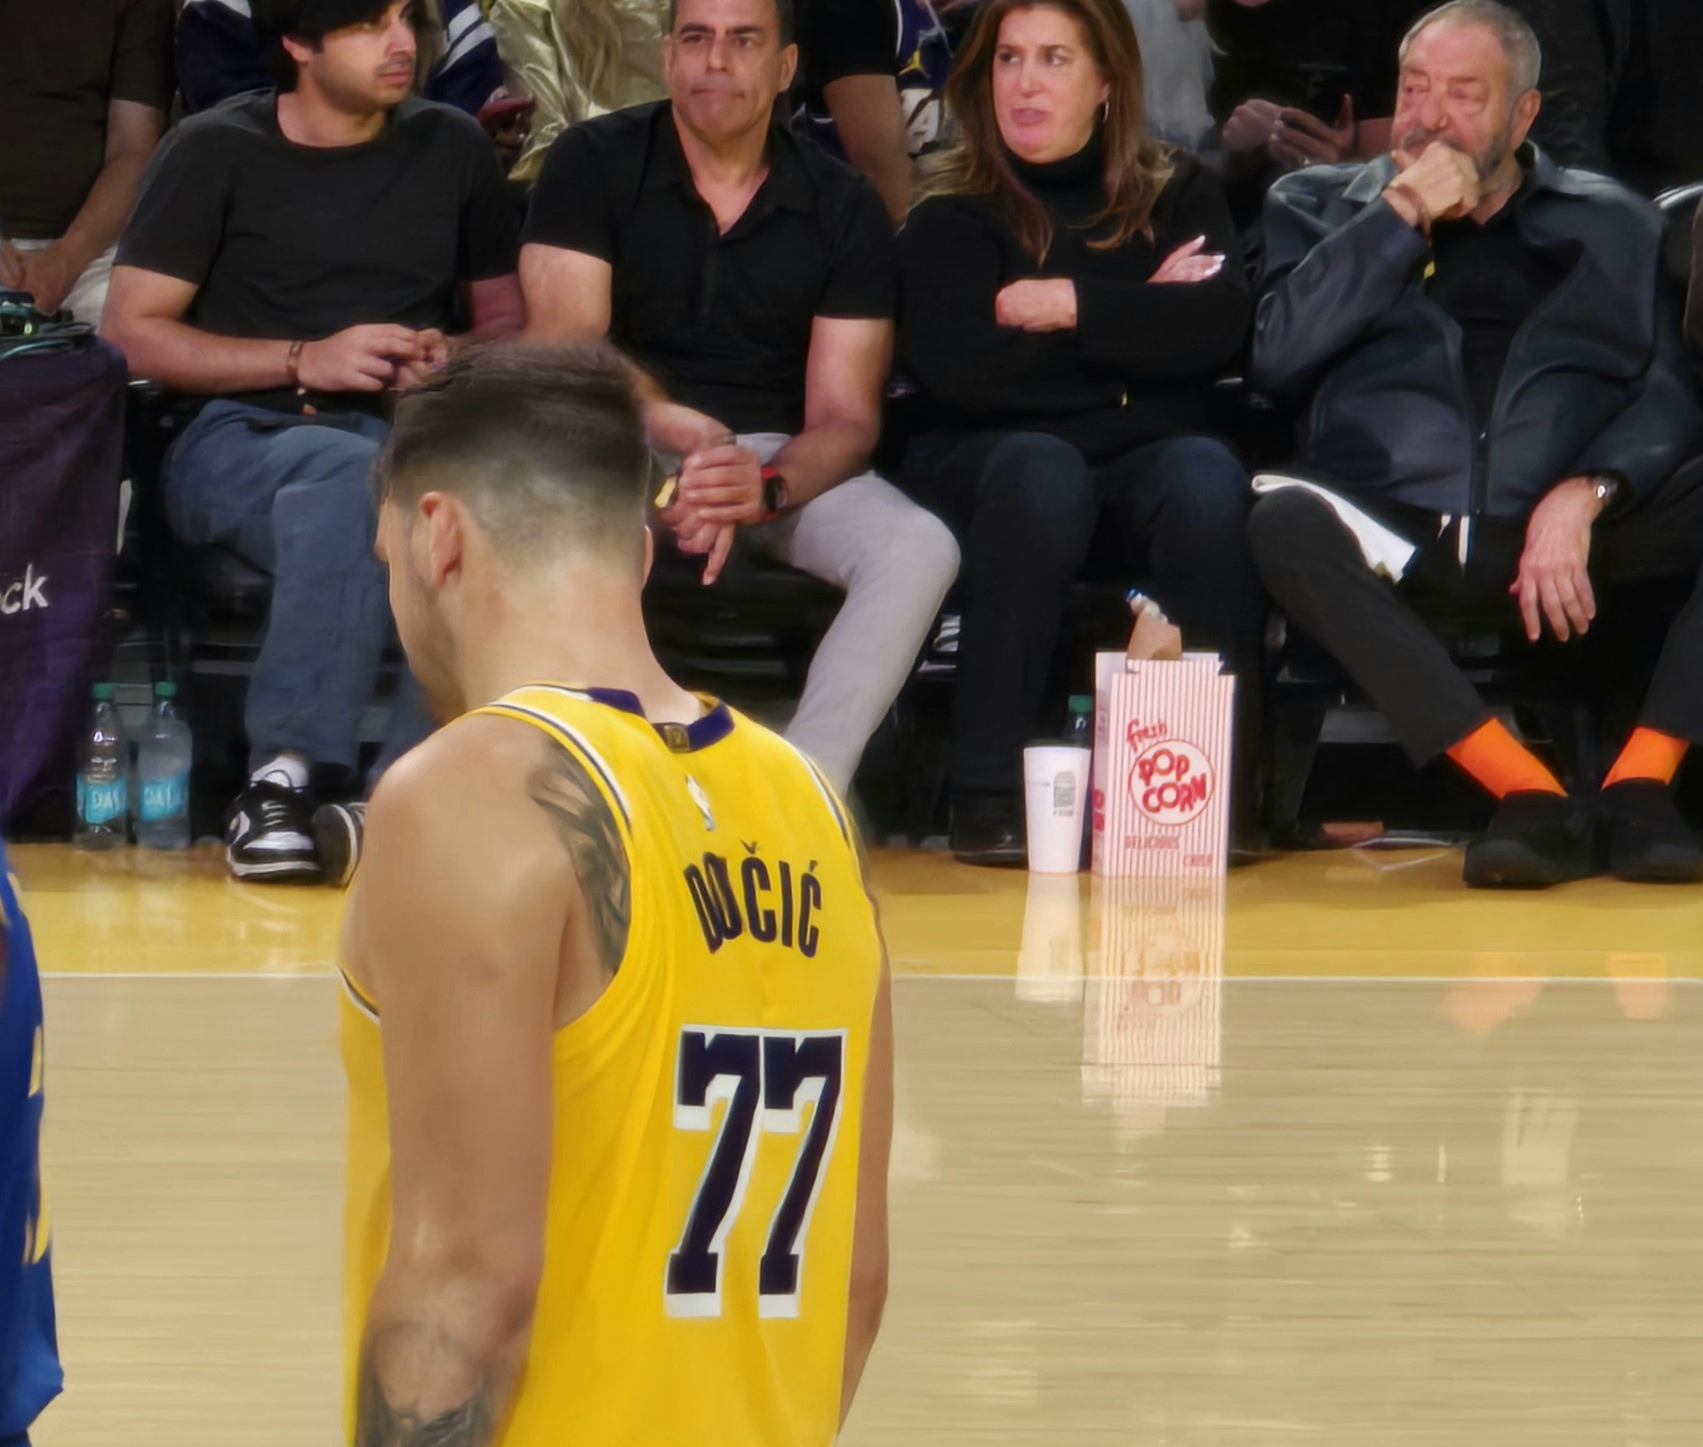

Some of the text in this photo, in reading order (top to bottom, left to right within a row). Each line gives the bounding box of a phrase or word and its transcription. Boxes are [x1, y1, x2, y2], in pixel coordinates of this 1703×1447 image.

[1126, 718, 1168, 753] fresh
[1138, 748, 1191, 787] POP
[1142, 773, 1208, 814] CORN
[664, 1024, 848, 1319] 77
